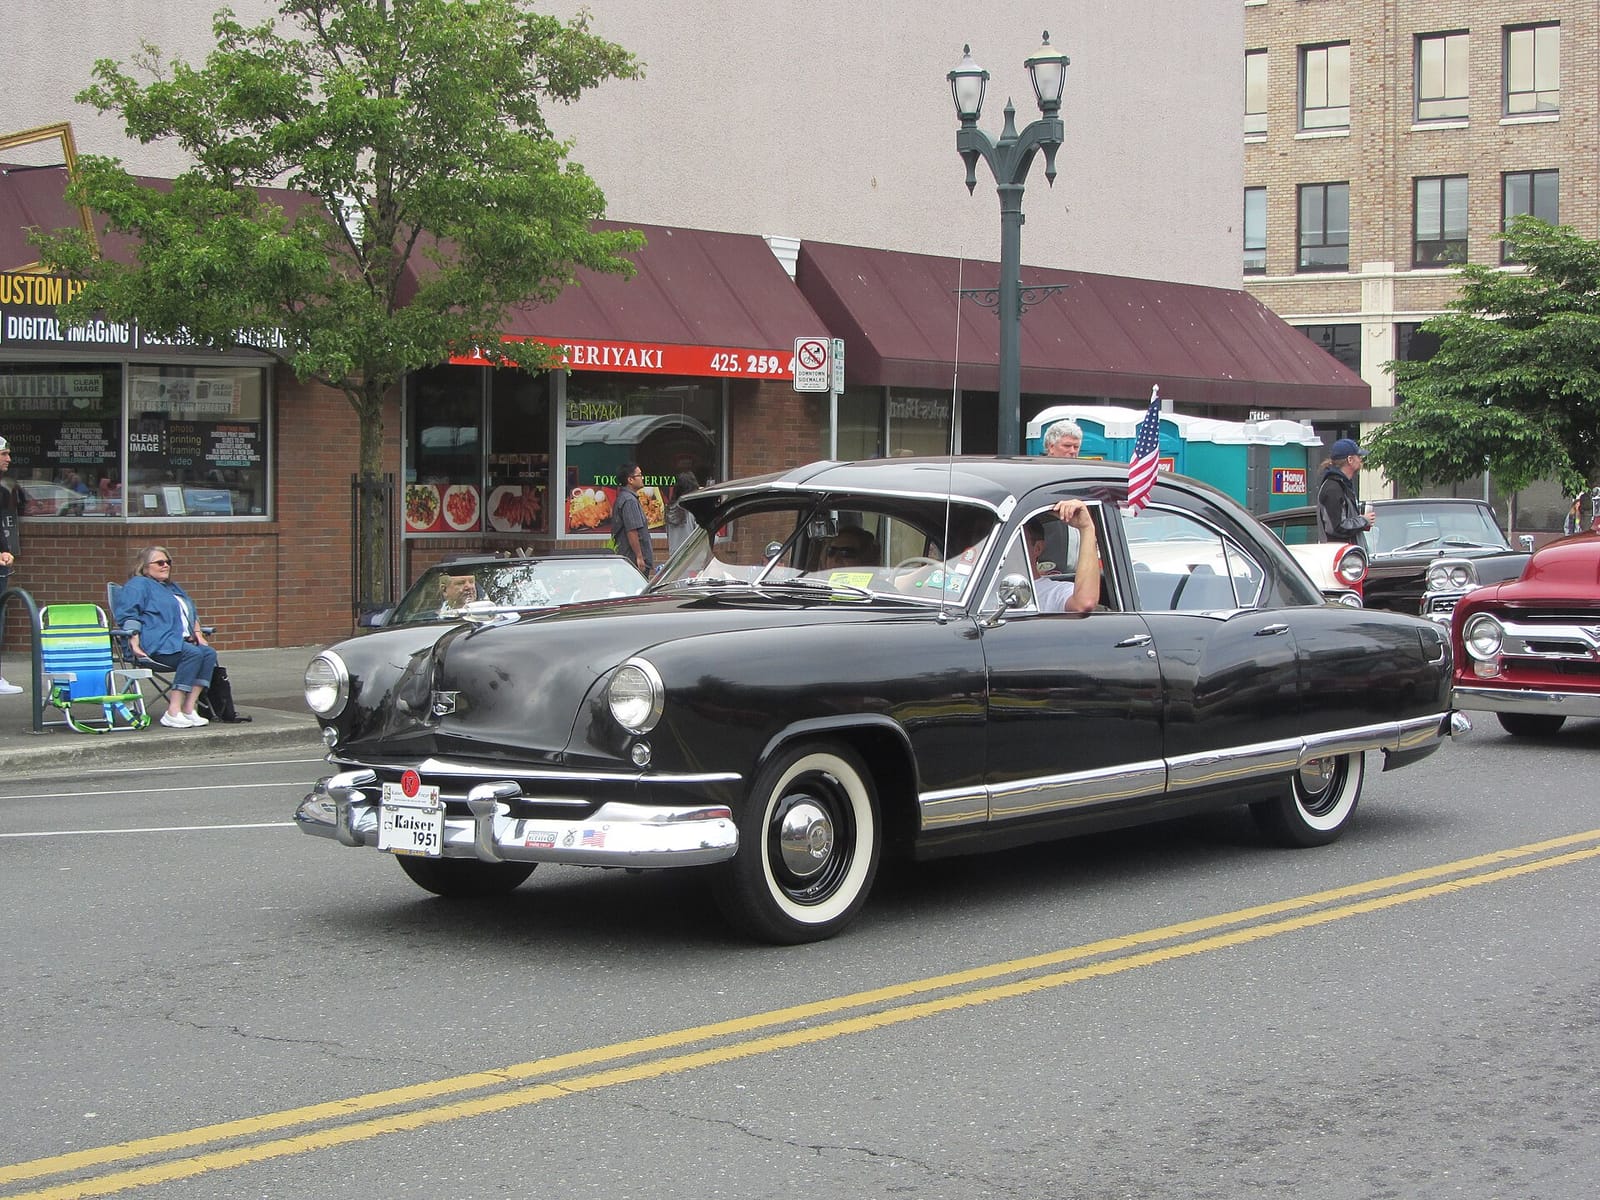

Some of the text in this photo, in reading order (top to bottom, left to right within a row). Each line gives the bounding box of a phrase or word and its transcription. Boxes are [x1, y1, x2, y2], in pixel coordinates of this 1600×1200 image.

[8, 317, 64, 341] DIGITAL
[68, 320, 129, 343] IMAGING
[561, 344, 663, 368] TERIYAKI
[710, 353, 742, 372] 425.
[747, 355, 783, 374] 259.
[566, 401, 623, 420] ERIYAKI
[170, 425, 194, 433] photo
[130, 434, 159, 442] CLEAR
[170, 434, 201, 445] printing
[169, 456, 192, 465] video
[594, 475, 676, 486] TOK ERIYA
[395, 814, 434, 831] Kaiser
[413, 832, 437, 847] 1951
